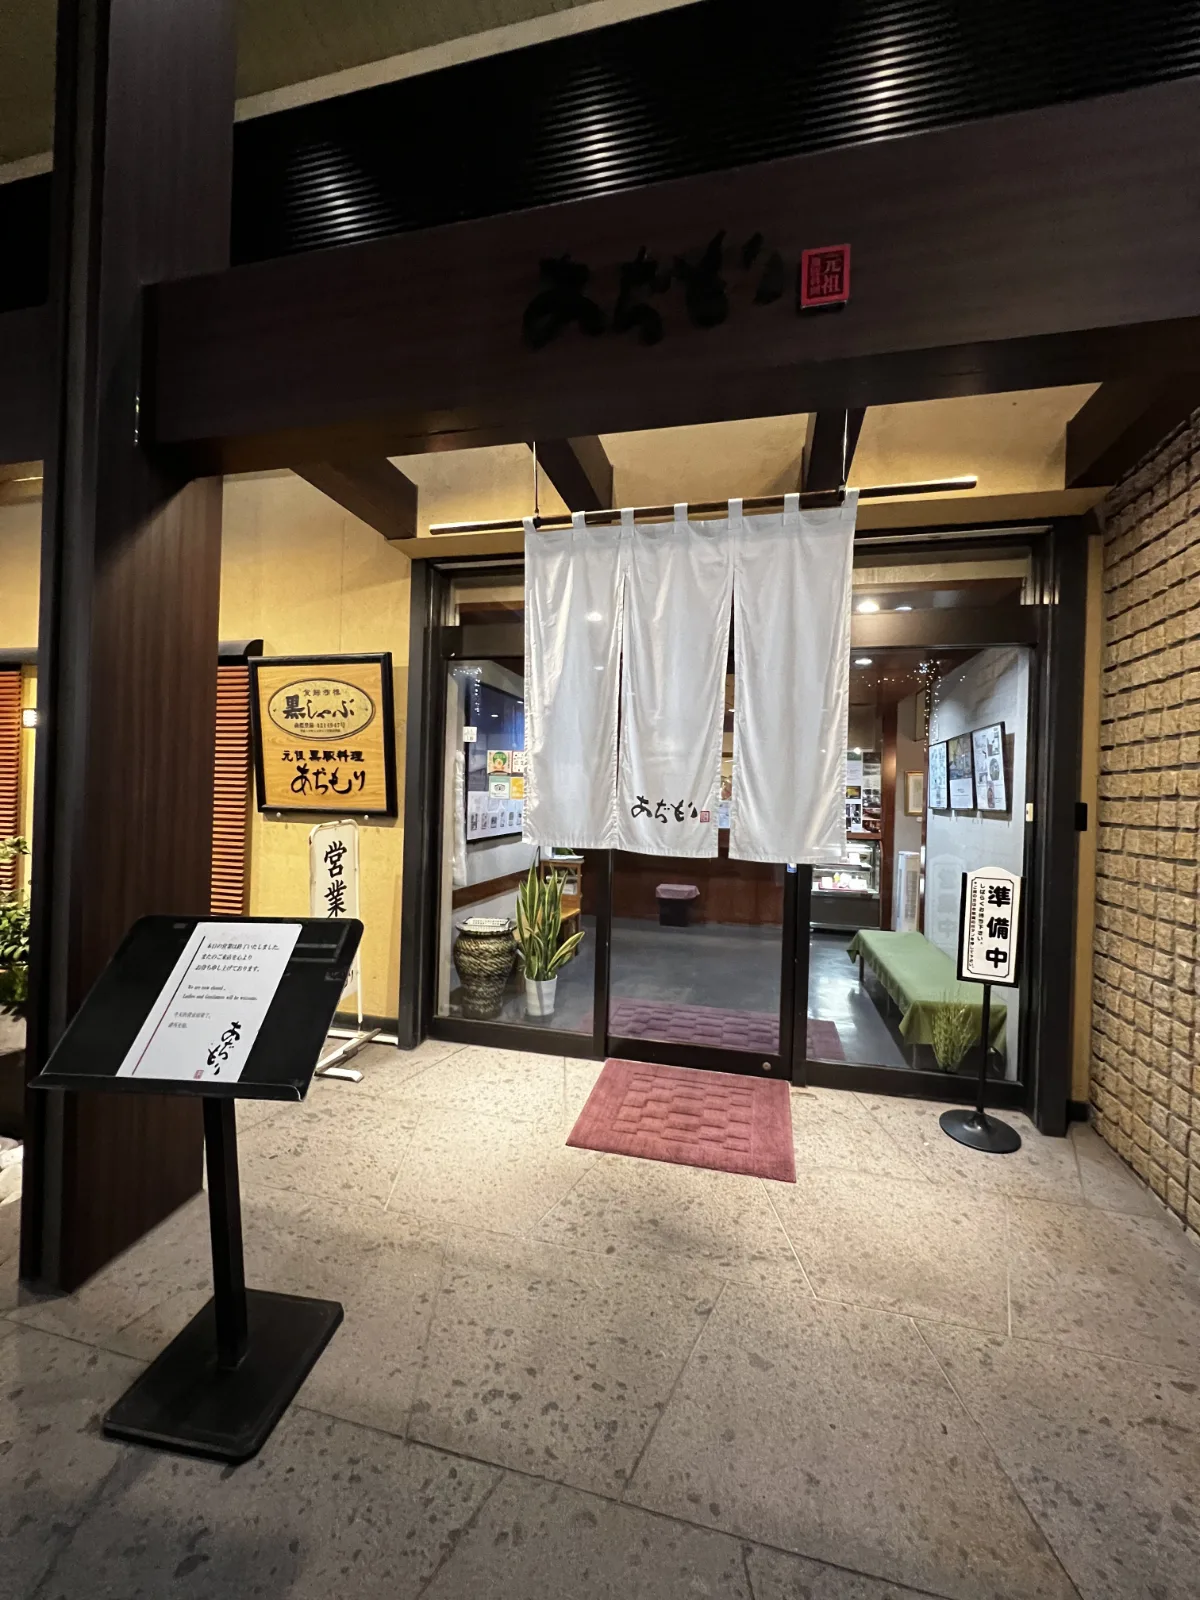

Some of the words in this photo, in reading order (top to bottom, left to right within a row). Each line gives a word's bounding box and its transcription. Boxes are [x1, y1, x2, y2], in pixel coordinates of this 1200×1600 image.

[283, 694, 355, 719] 黒しゃぶ
[291, 763, 365, 796] あぢもり
[631, 795, 698, 823] あぢもり
[986, 886, 1011, 968] 準備中
